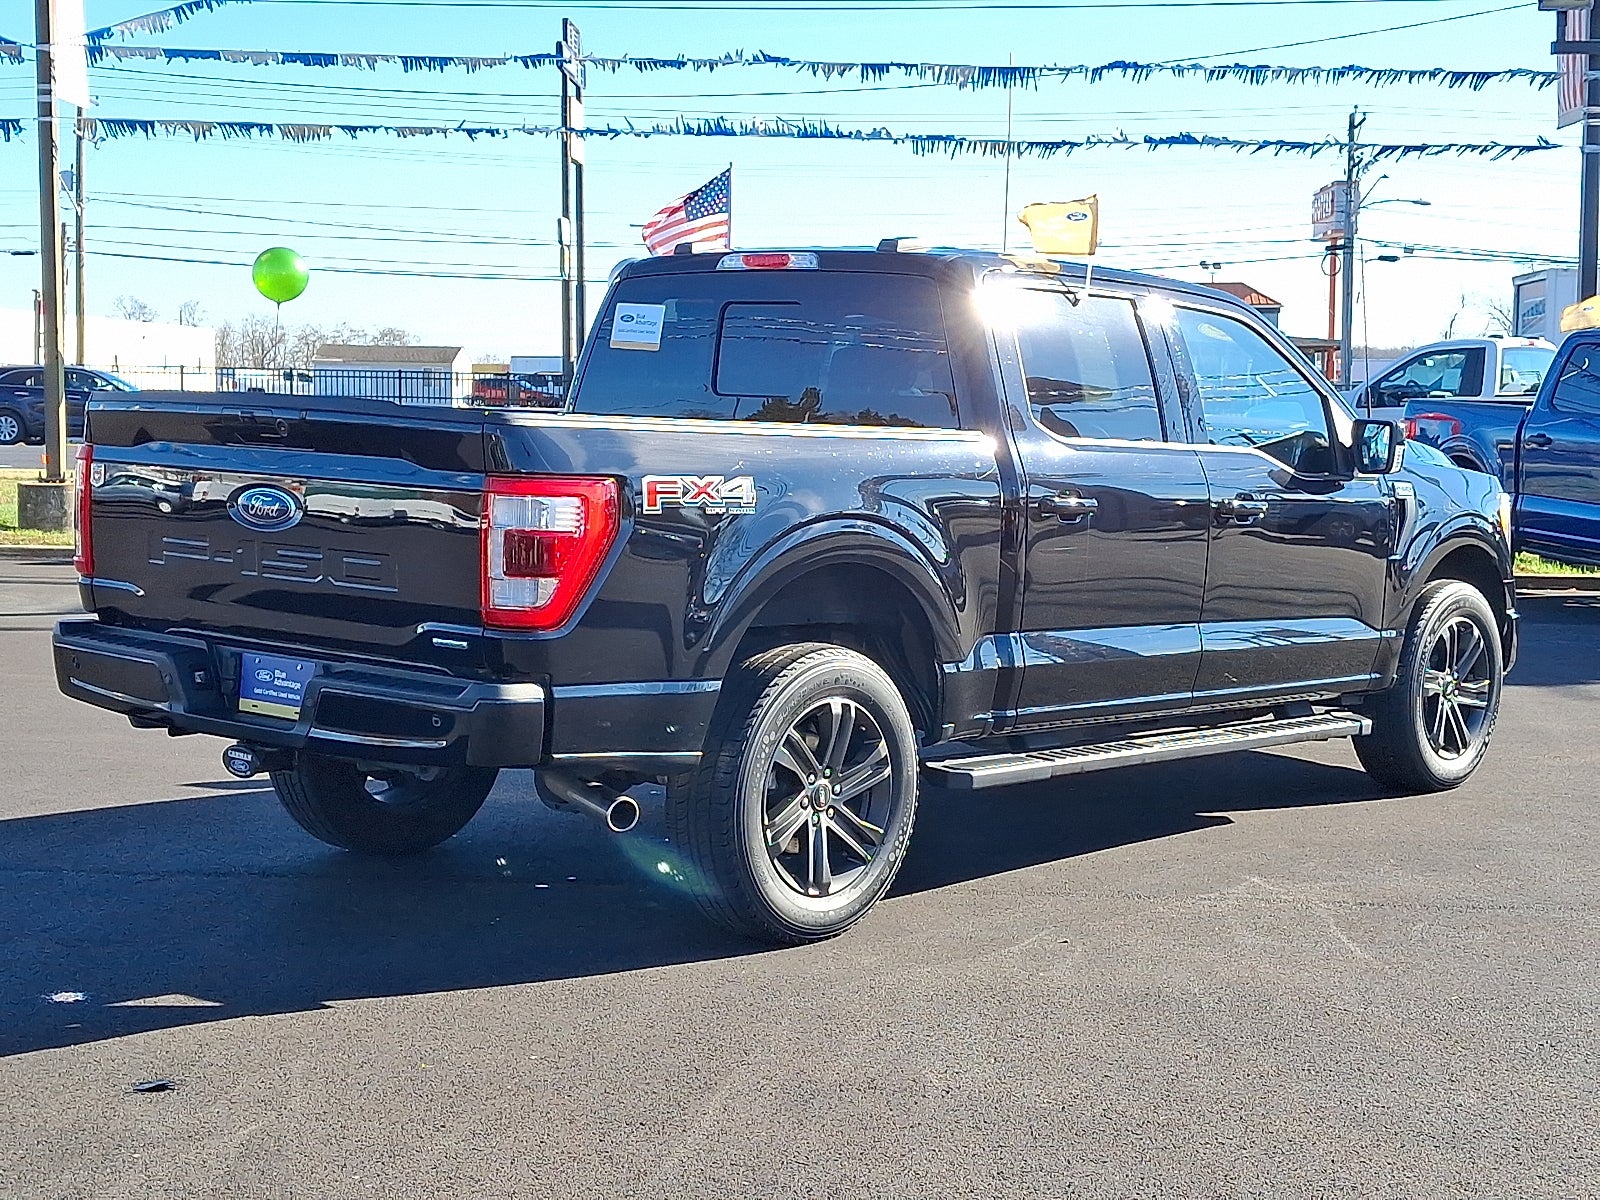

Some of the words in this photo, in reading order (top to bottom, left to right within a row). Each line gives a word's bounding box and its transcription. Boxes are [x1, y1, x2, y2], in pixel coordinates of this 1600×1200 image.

[248, 494, 281, 517] Ford
[641, 475, 757, 514] FX4
[148, 536, 398, 593] F-150
